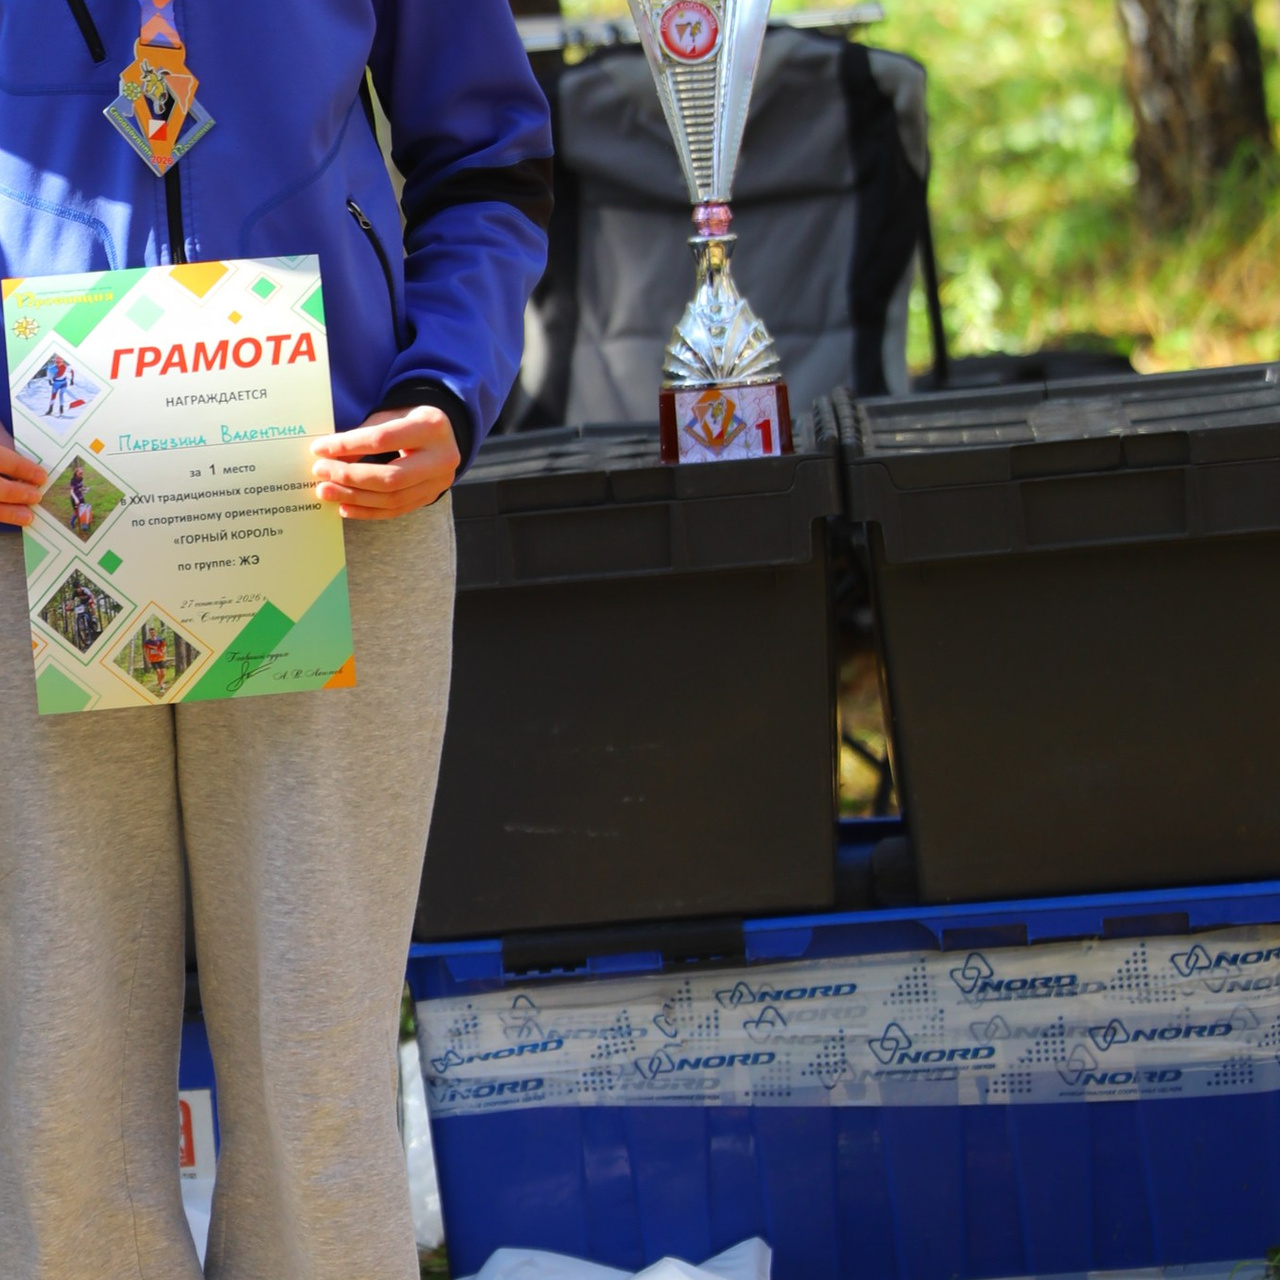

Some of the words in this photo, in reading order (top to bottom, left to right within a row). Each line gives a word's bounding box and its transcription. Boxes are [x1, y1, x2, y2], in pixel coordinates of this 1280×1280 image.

[110, 332, 317, 380] ГРАМОТА
[165, 388, 268, 408] НАГРАЖДАЕТСЯ
[755, 418, 773, 455] 1
[189, 468, 202, 478] за
[209, 464, 216, 475] 1
[222, 464, 256, 475] место
[120, 497, 127, 506] в
[129, 494, 155, 505] XXVI
[157, 487, 242, 504] традиционных
[131, 518, 145, 528] по
[148, 511, 221, 527] спортивному
[224, 503, 323, 520] ориентированию
[173, 532, 228, 546] «ГОРНЫЙ
[230, 527, 283, 541] КОРОЛЬ»
[177, 562, 192, 572] по
[194, 558, 236, 572] группе:
[239, 554, 260, 567] ЖЭ
[756, 982, 858, 1004] NORD
[978, 973, 1078, 994] NORD
[1131, 1023, 1233, 1043] NORD
[466, 1037, 565, 1064] NORD
[895, 1045, 996, 1065] NORD
[675, 1052, 776, 1072] NORD
[1081, 1068, 1183, 1087] NORD
[448, 1077, 544, 1103] NORD
